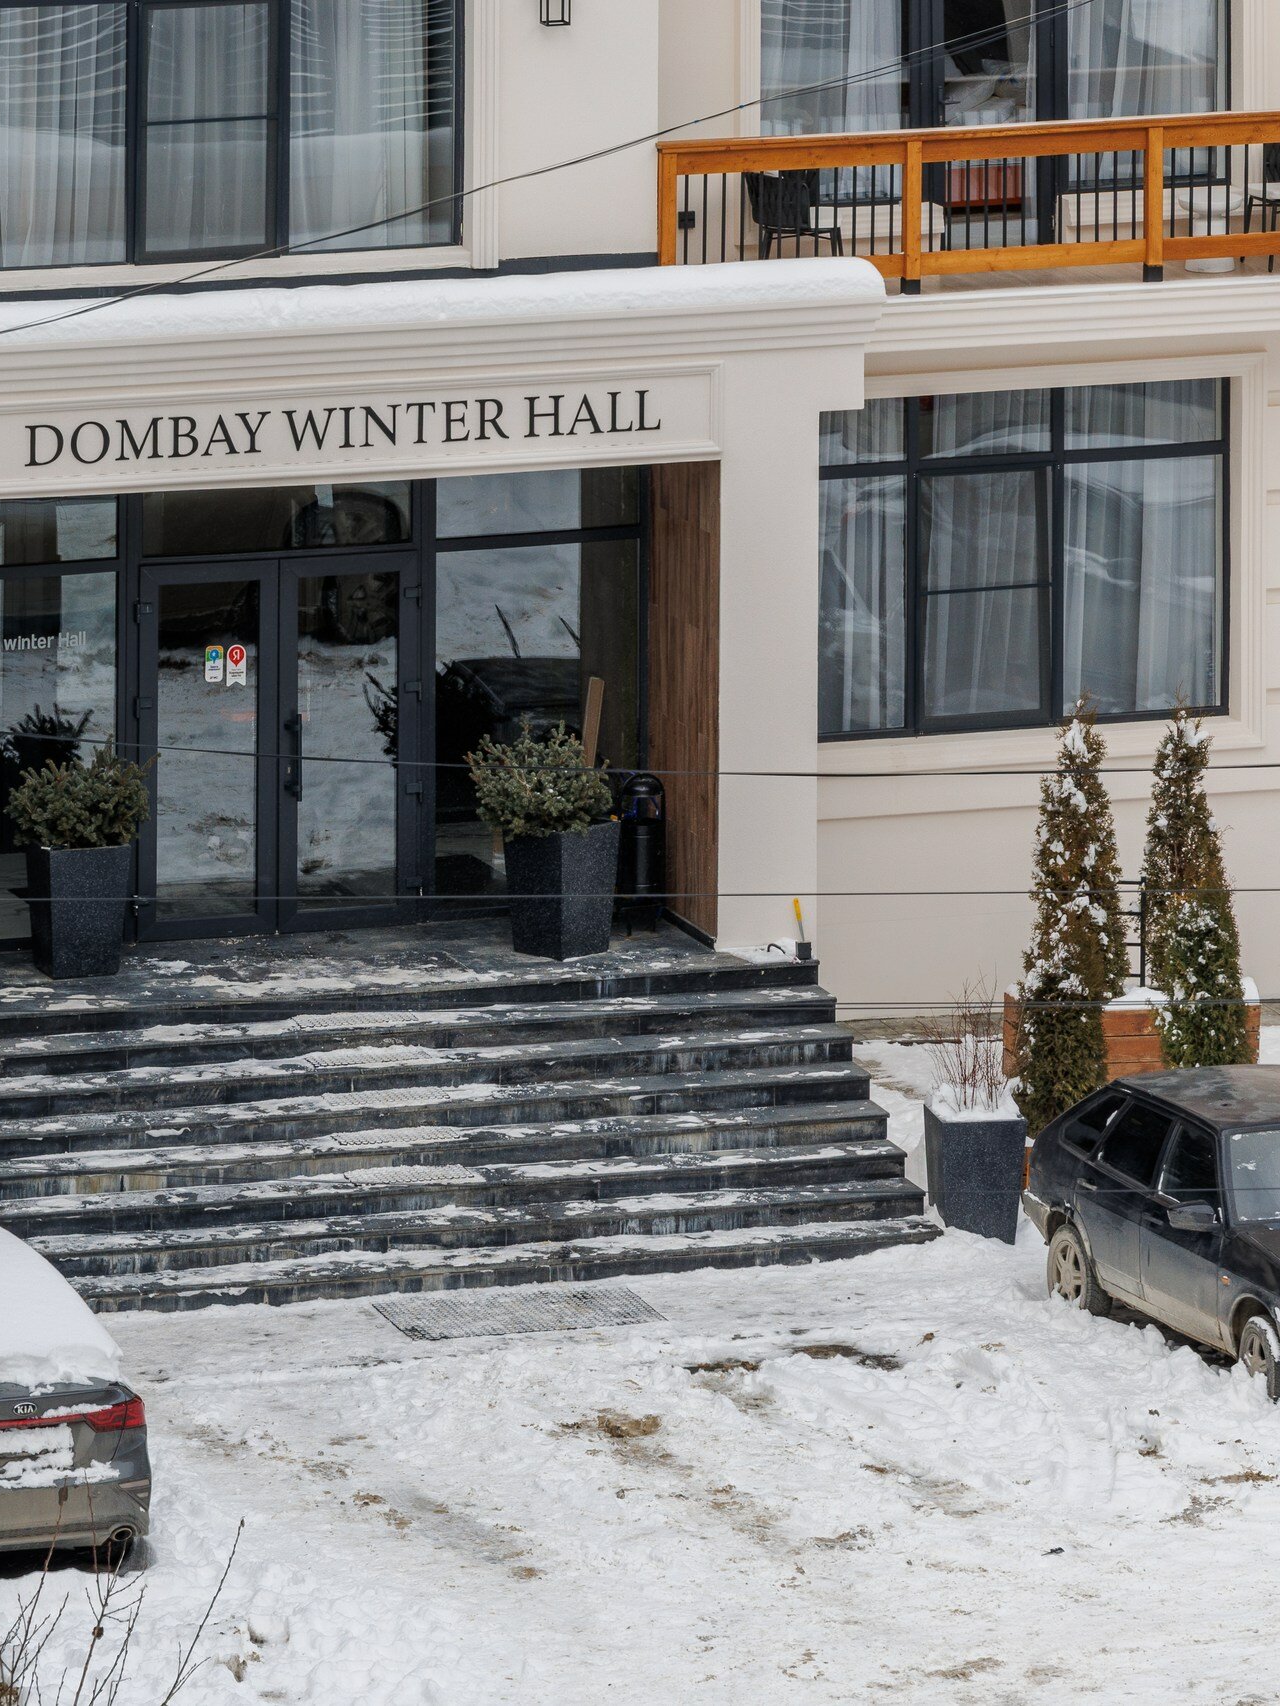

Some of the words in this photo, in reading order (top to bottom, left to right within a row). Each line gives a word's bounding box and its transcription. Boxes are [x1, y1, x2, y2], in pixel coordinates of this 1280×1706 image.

[24, 411, 272, 467] DOMBAY
[282, 398, 510, 452] WINTER
[523, 389, 661, 438] HALL
[3, 633, 55, 651] winter
[58, 630, 87, 648] Hall
[232, 649, 240, 661] Я
[17, 1405, 34, 1414] KIA
